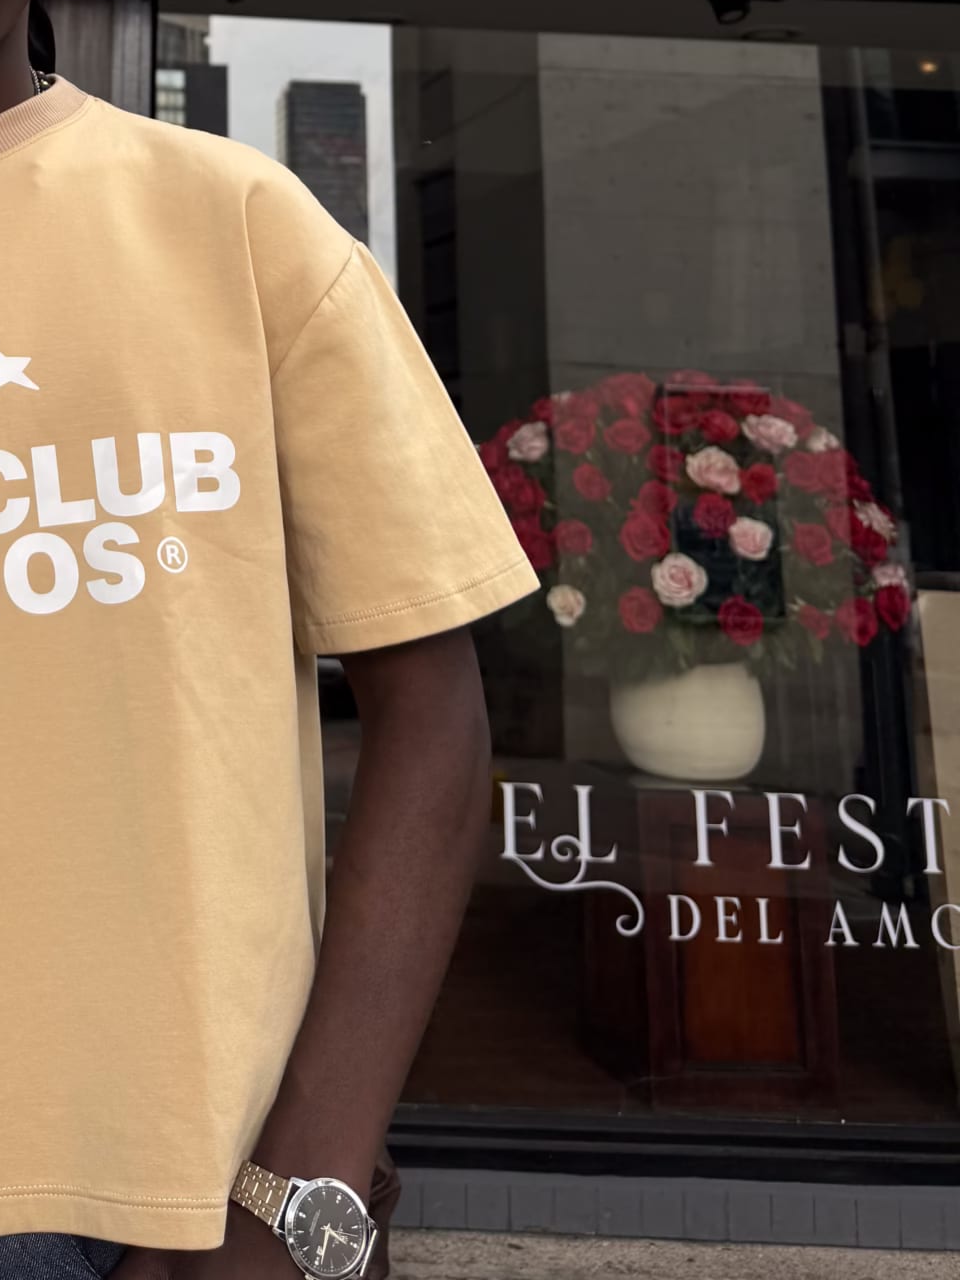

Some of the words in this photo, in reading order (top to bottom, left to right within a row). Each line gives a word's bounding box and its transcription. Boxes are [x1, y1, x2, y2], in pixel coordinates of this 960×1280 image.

[499, 781, 644, 937] EL
[691, 789, 951, 874] FEST
[667, 894, 785, 945] DEL
